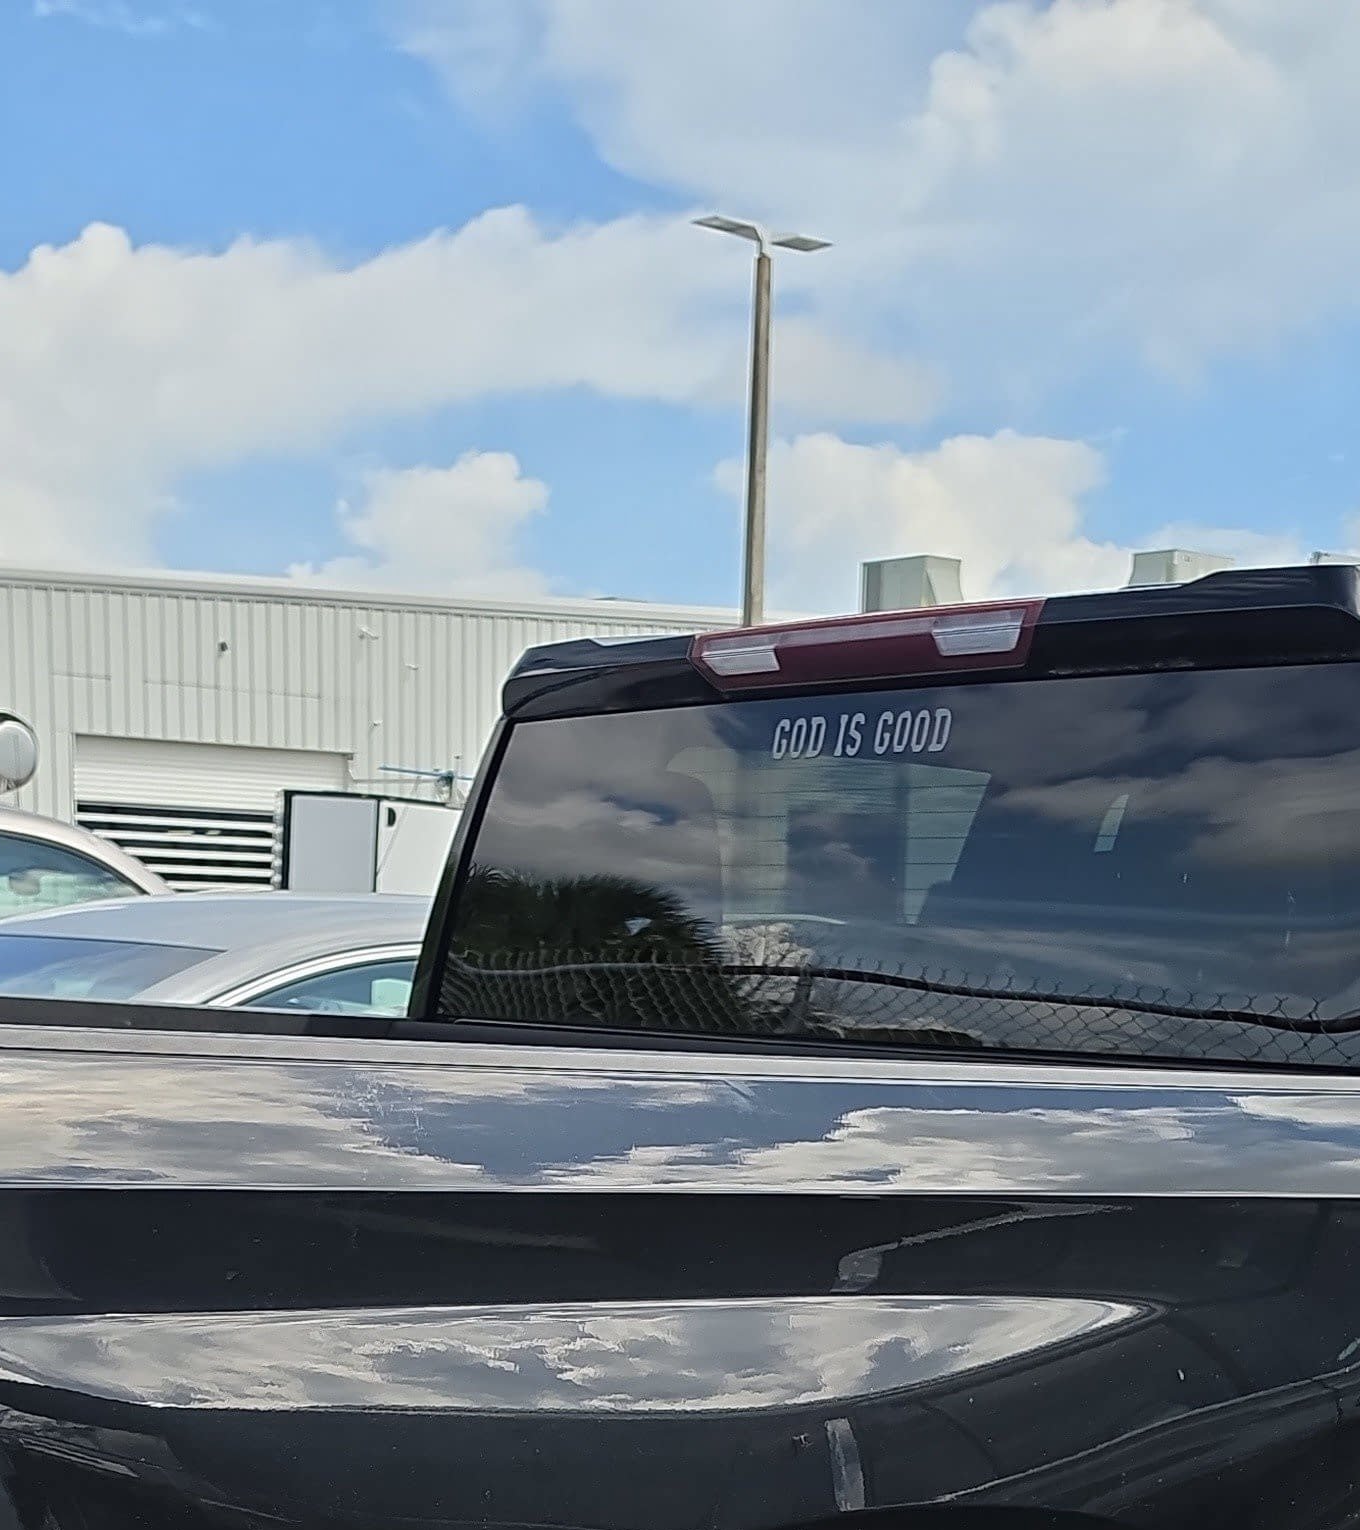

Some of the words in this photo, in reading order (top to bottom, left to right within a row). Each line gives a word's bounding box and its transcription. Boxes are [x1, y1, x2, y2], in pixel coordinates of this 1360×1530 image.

[772, 716, 827, 760] GOD
[833, 712, 866, 757] IS
[873, 708, 952, 756] GOOD
